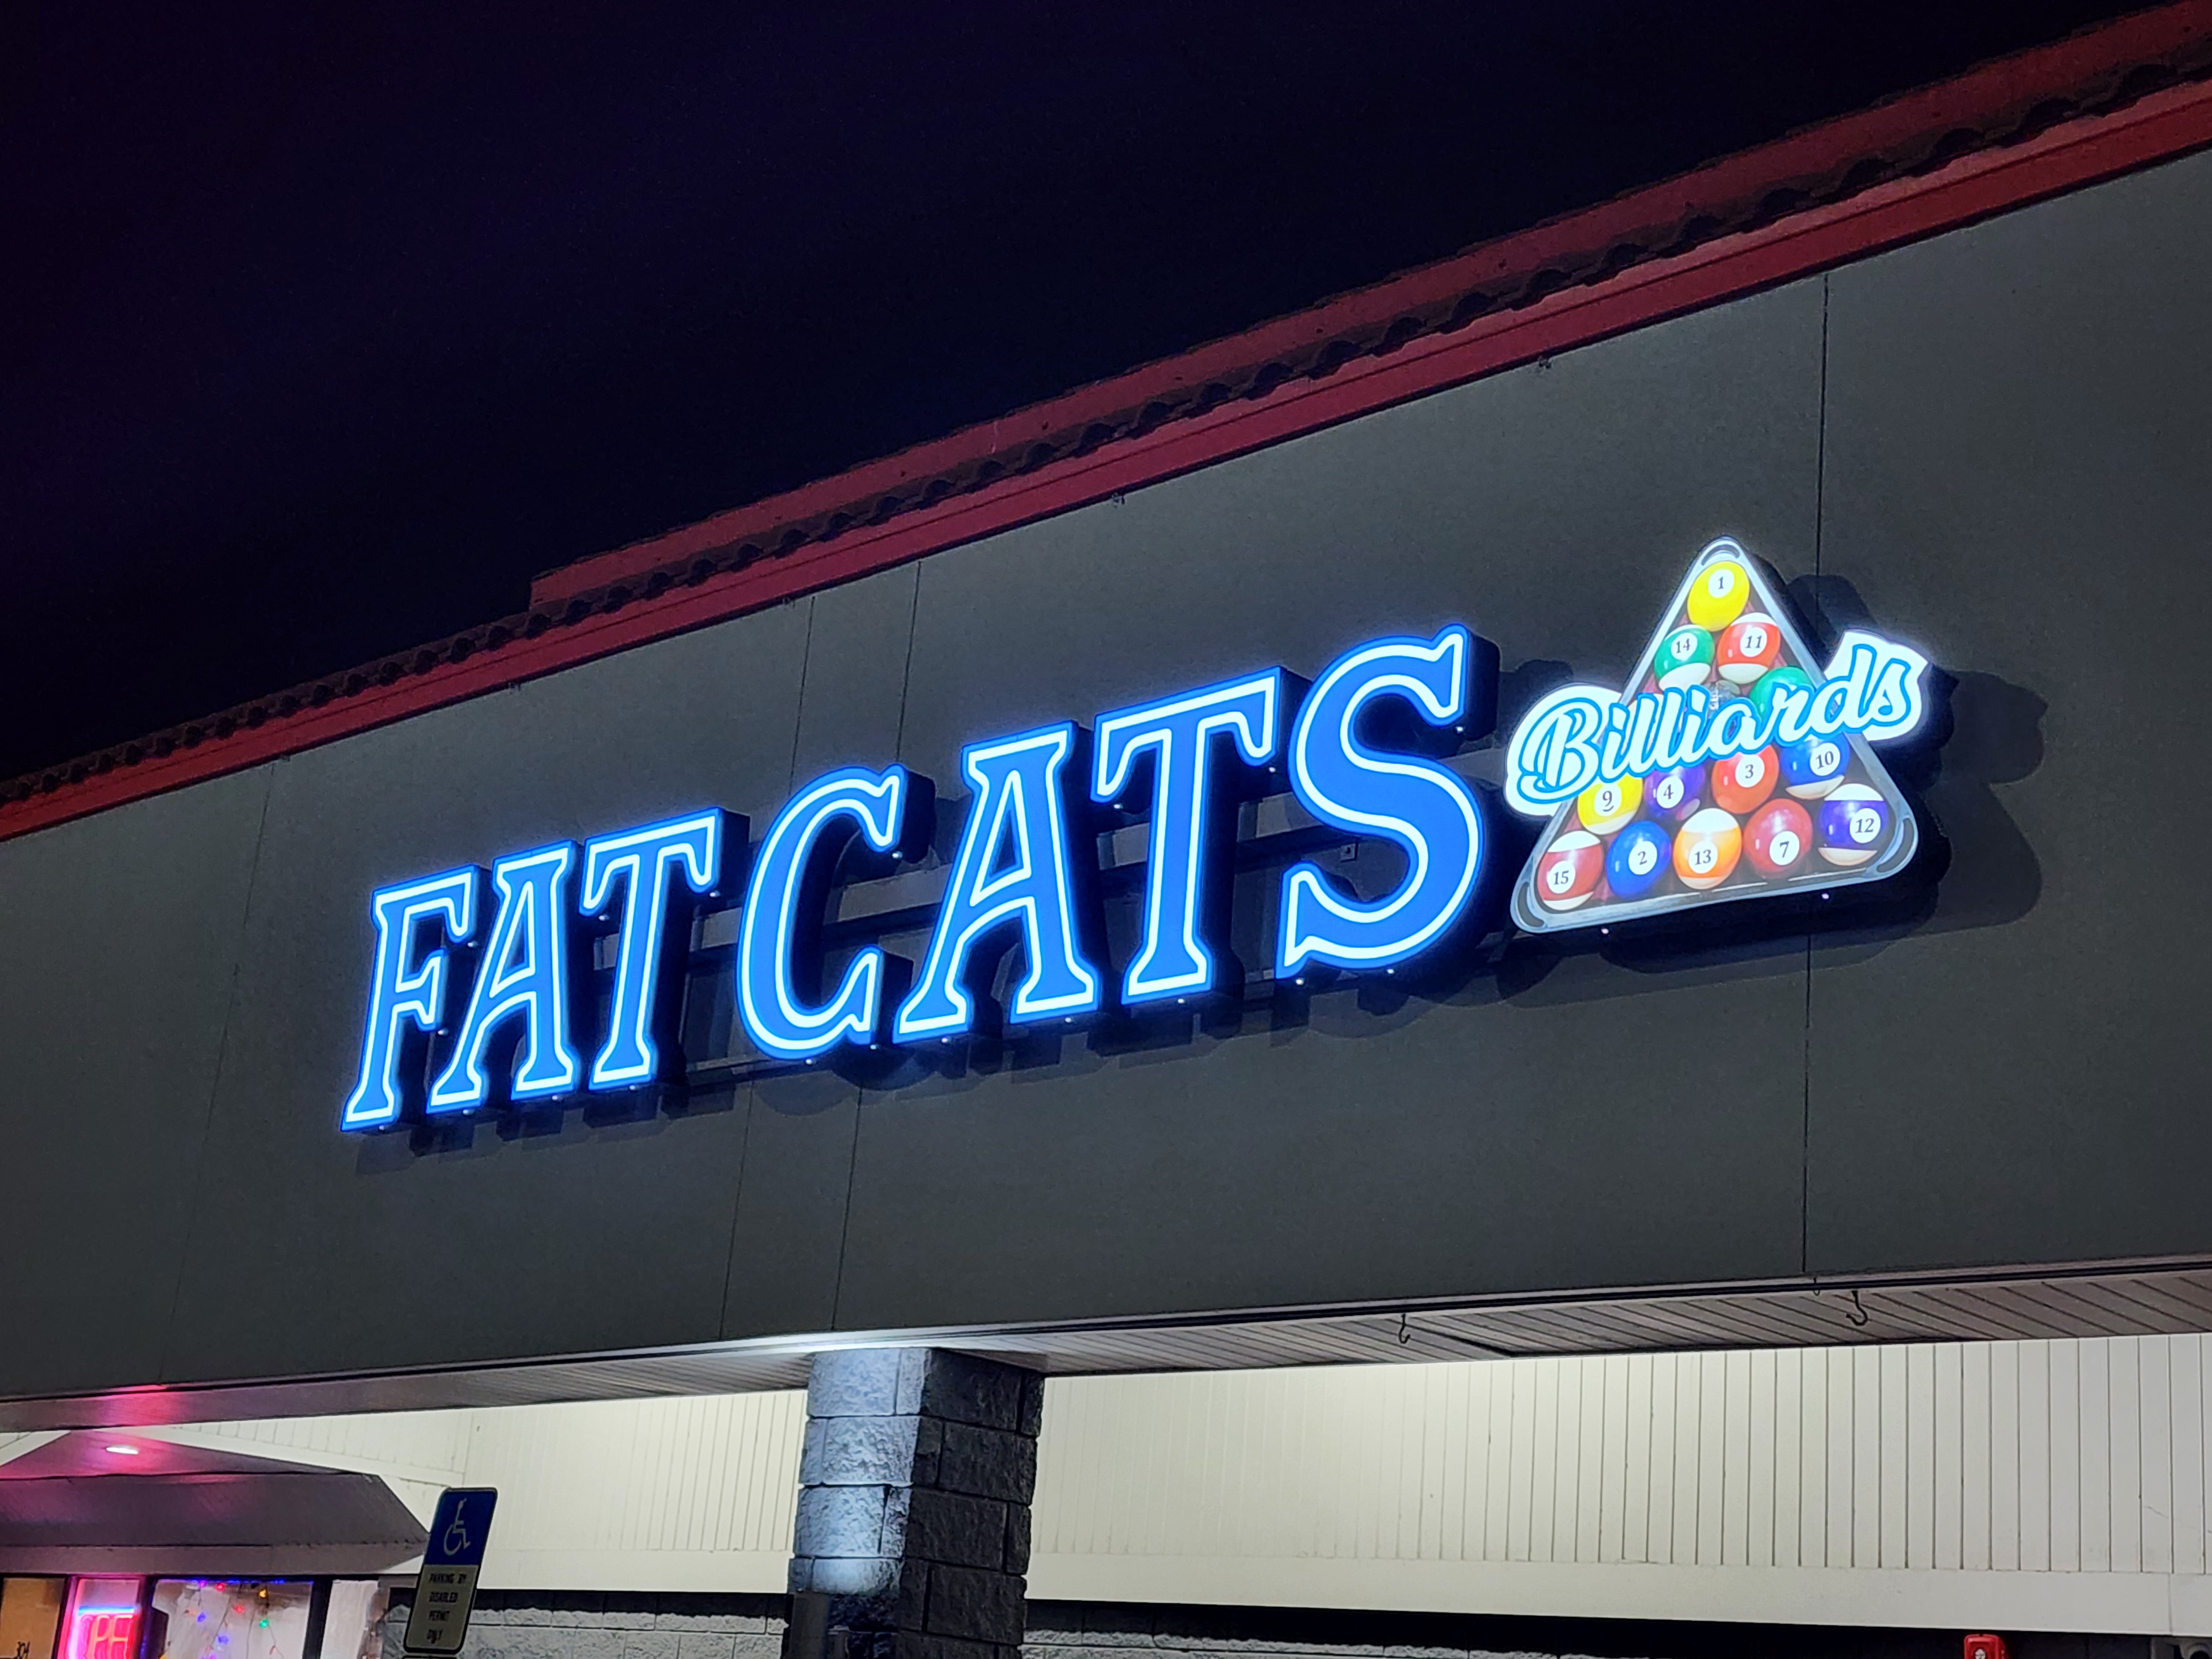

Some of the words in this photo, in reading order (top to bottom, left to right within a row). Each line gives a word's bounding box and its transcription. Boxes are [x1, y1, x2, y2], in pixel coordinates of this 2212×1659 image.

[1717, 576, 1725, 590] 1
[1675, 637, 1691, 654] 14
[1744, 634, 1762, 649] 11
[1516, 643, 1911, 804] Billiards
[1814, 750, 1834, 770] 10
[1744, 764, 1755, 779] 3
[1601, 790, 1614, 809] 9
[1662, 784, 1674, 800] 4
[1854, 817, 1875, 834] 12
[1693, 849, 1712, 865] 13
[1778, 841, 1790, 858] 7
[1637, 850, 1648, 866] 2
[340, 806, 726, 1133] FAT
[737, 623, 1485, 1063] CATS
[1552, 870, 1570, 886] 15
